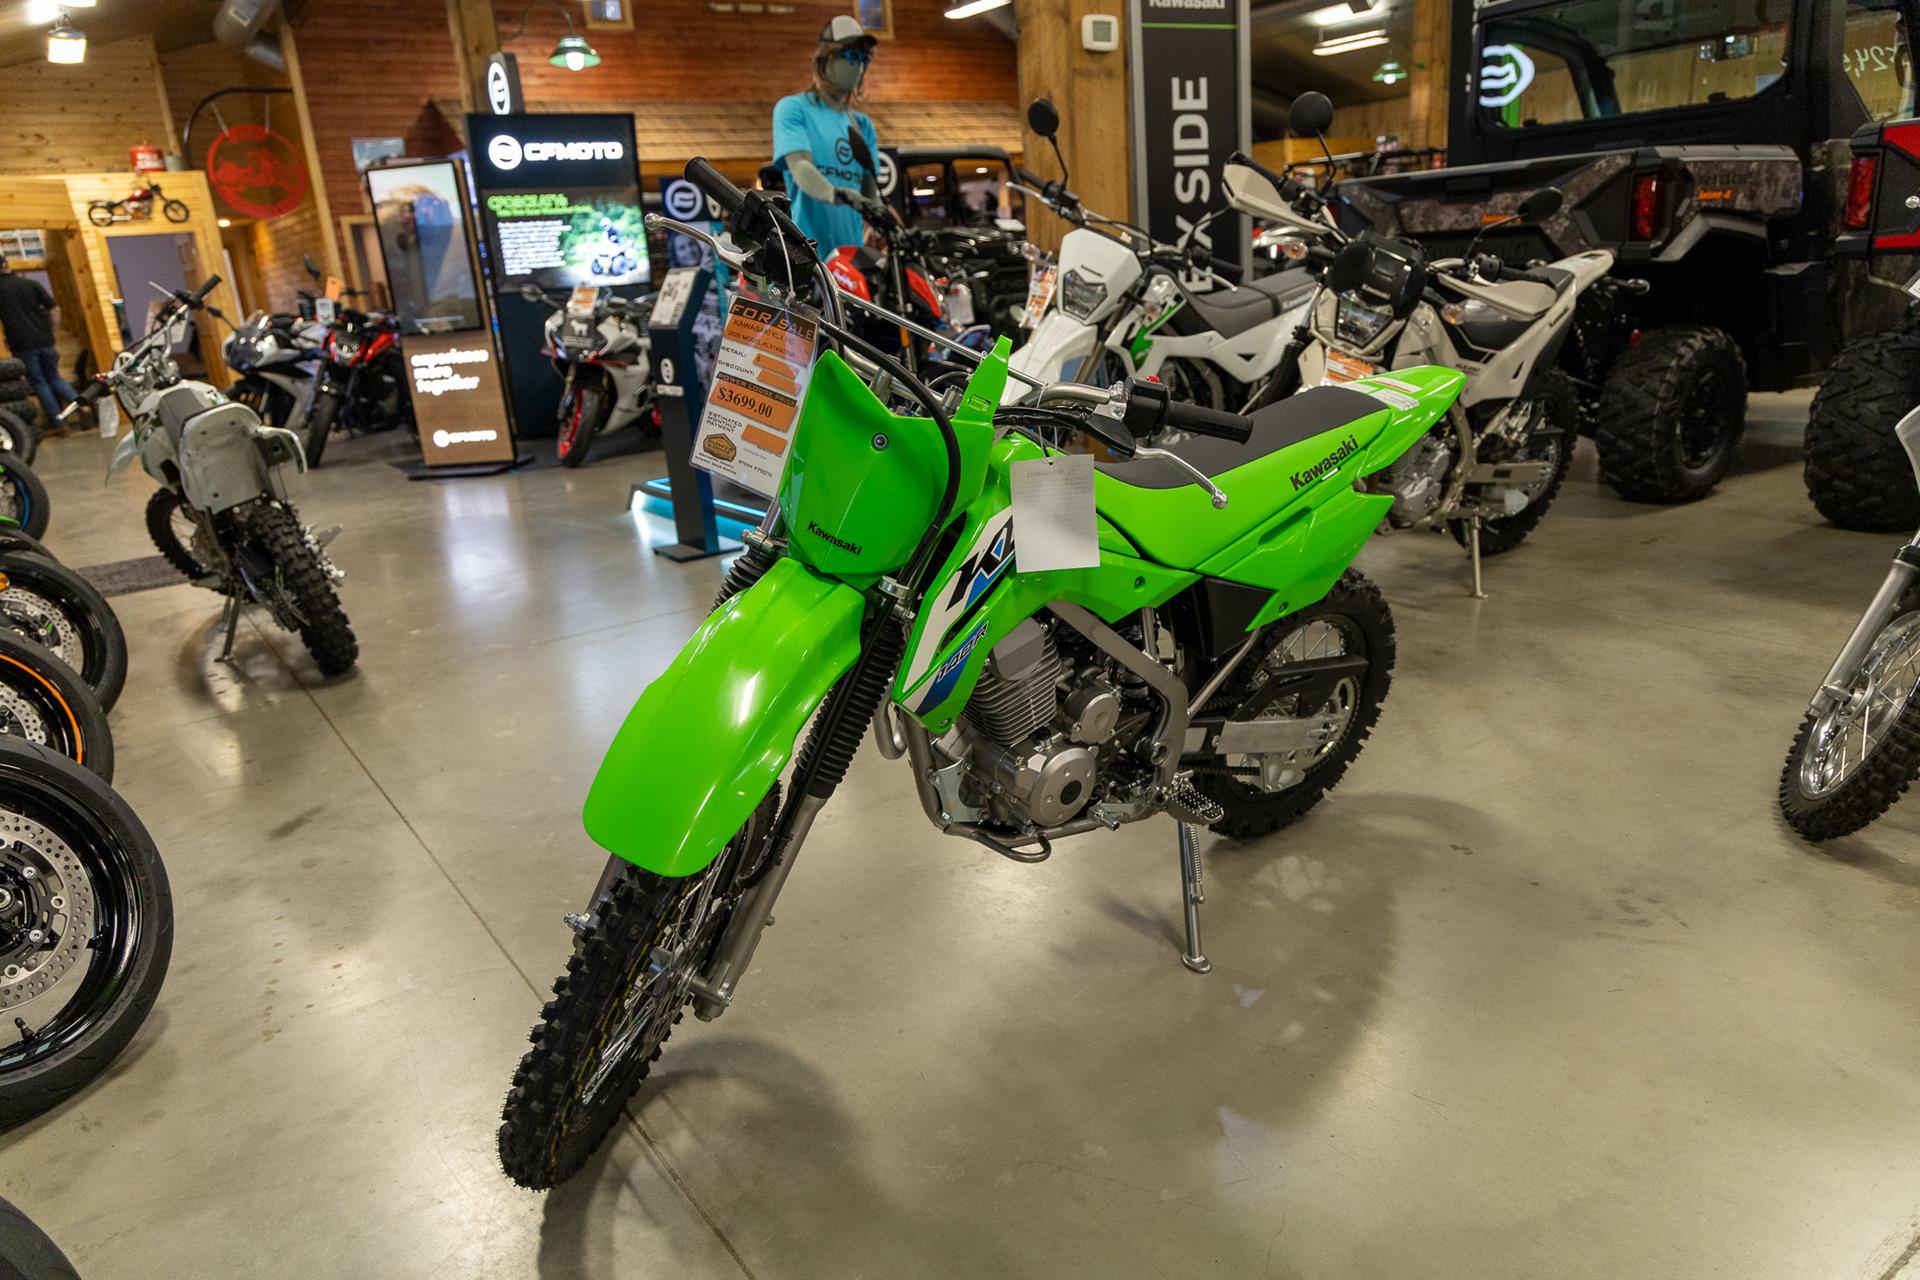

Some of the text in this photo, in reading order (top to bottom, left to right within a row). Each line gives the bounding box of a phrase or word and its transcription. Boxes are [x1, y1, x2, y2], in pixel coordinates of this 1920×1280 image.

[523, 141, 624, 161] CFMOTO
[1171, 76, 1211, 204] SIDE
[731, 303, 814, 342] FOR SALE
[733, 319, 771, 337] KAWASAKI
[718, 373, 747, 388] POWER
[717, 387, 773, 418] $3699.00
[706, 420, 735, 434] PAYMENT
[707, 416, 737, 429] MONTHLY
[708, 411, 743, 428] ESTIMATED
[1289, 434, 1360, 491] Kawasaki
[808, 521, 863, 556] Kawasaki
[936, 620, 989, 684] 140R
